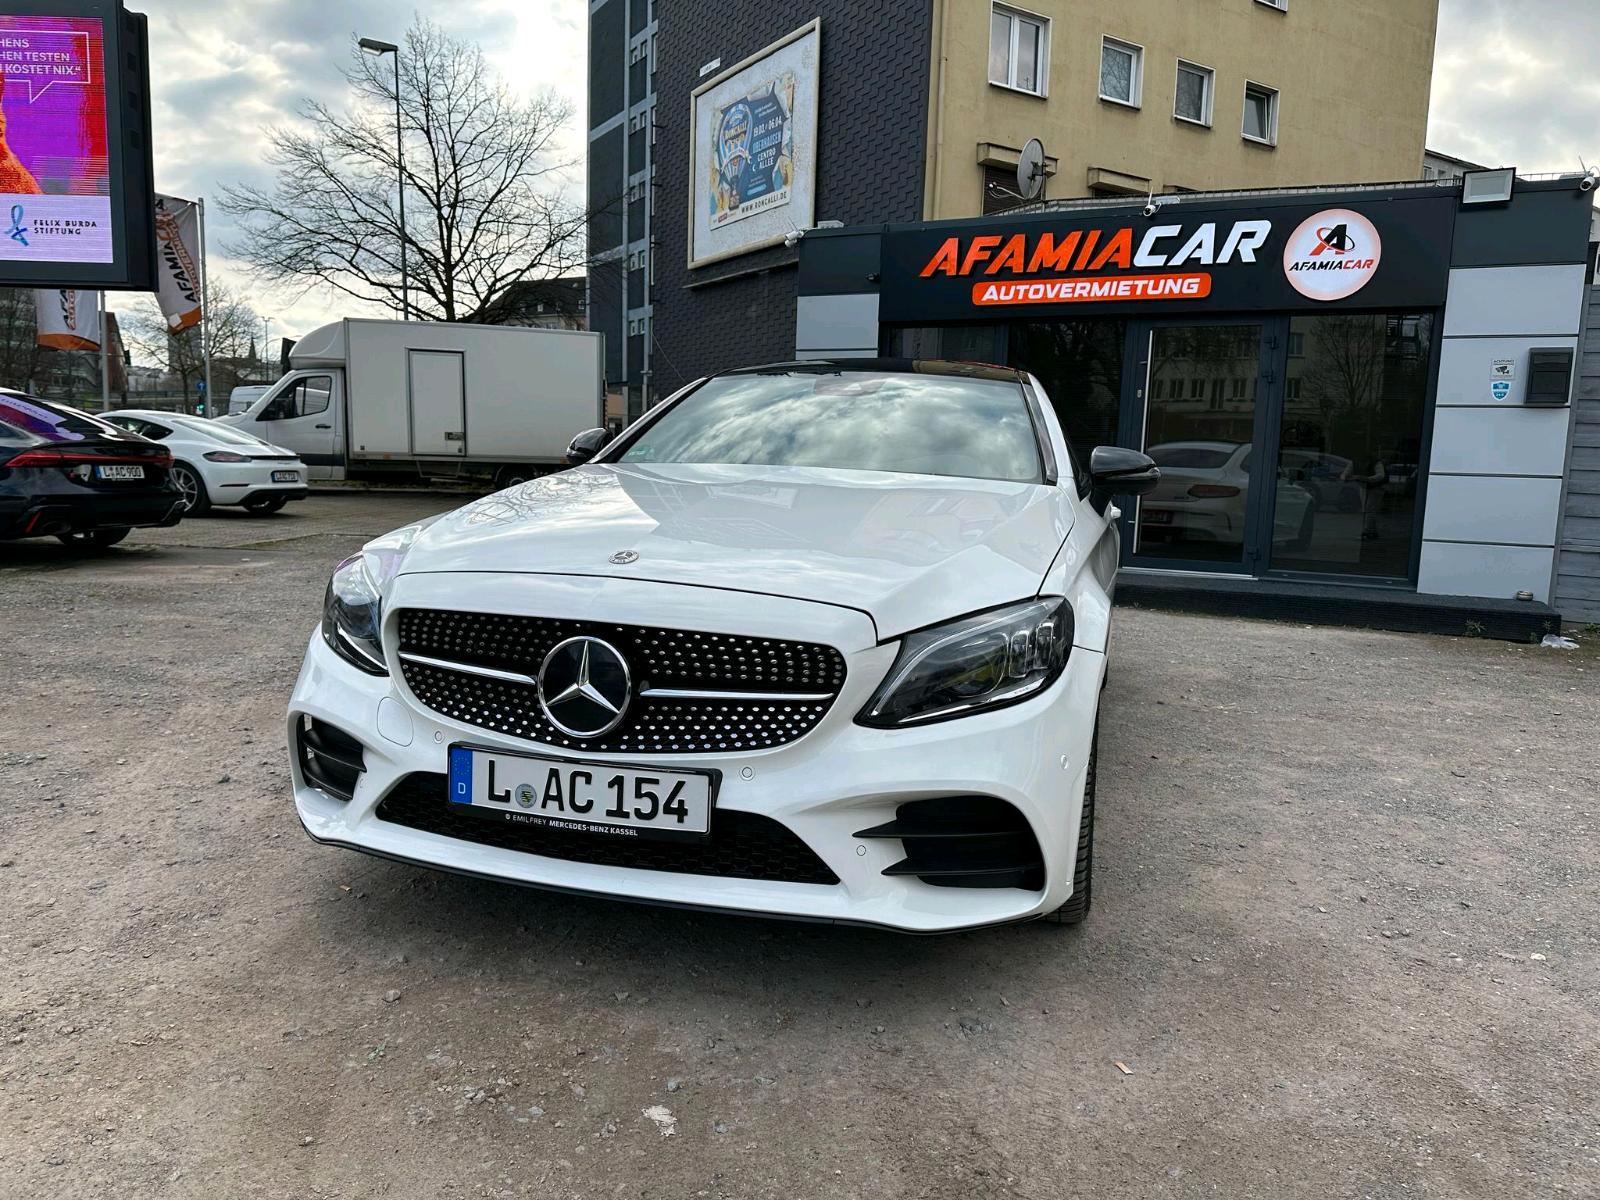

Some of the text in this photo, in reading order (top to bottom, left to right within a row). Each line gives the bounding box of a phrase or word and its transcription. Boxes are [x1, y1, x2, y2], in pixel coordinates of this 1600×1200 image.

[25, 52, 70, 62] TESTEN
[6, 64, 51, 74] KOSTET
[918, 219, 1272, 279] AFAMIACAR
[1288, 258, 1375, 272] AFAMIACAR
[981, 277, 1201, 303] AUTOVERMIETUNG
[457, 760, 689, 824] D L AC 154
[549, 820, 609, 834] MERCEDES-BENZ
[610, 826, 638, 836] KASSEL
